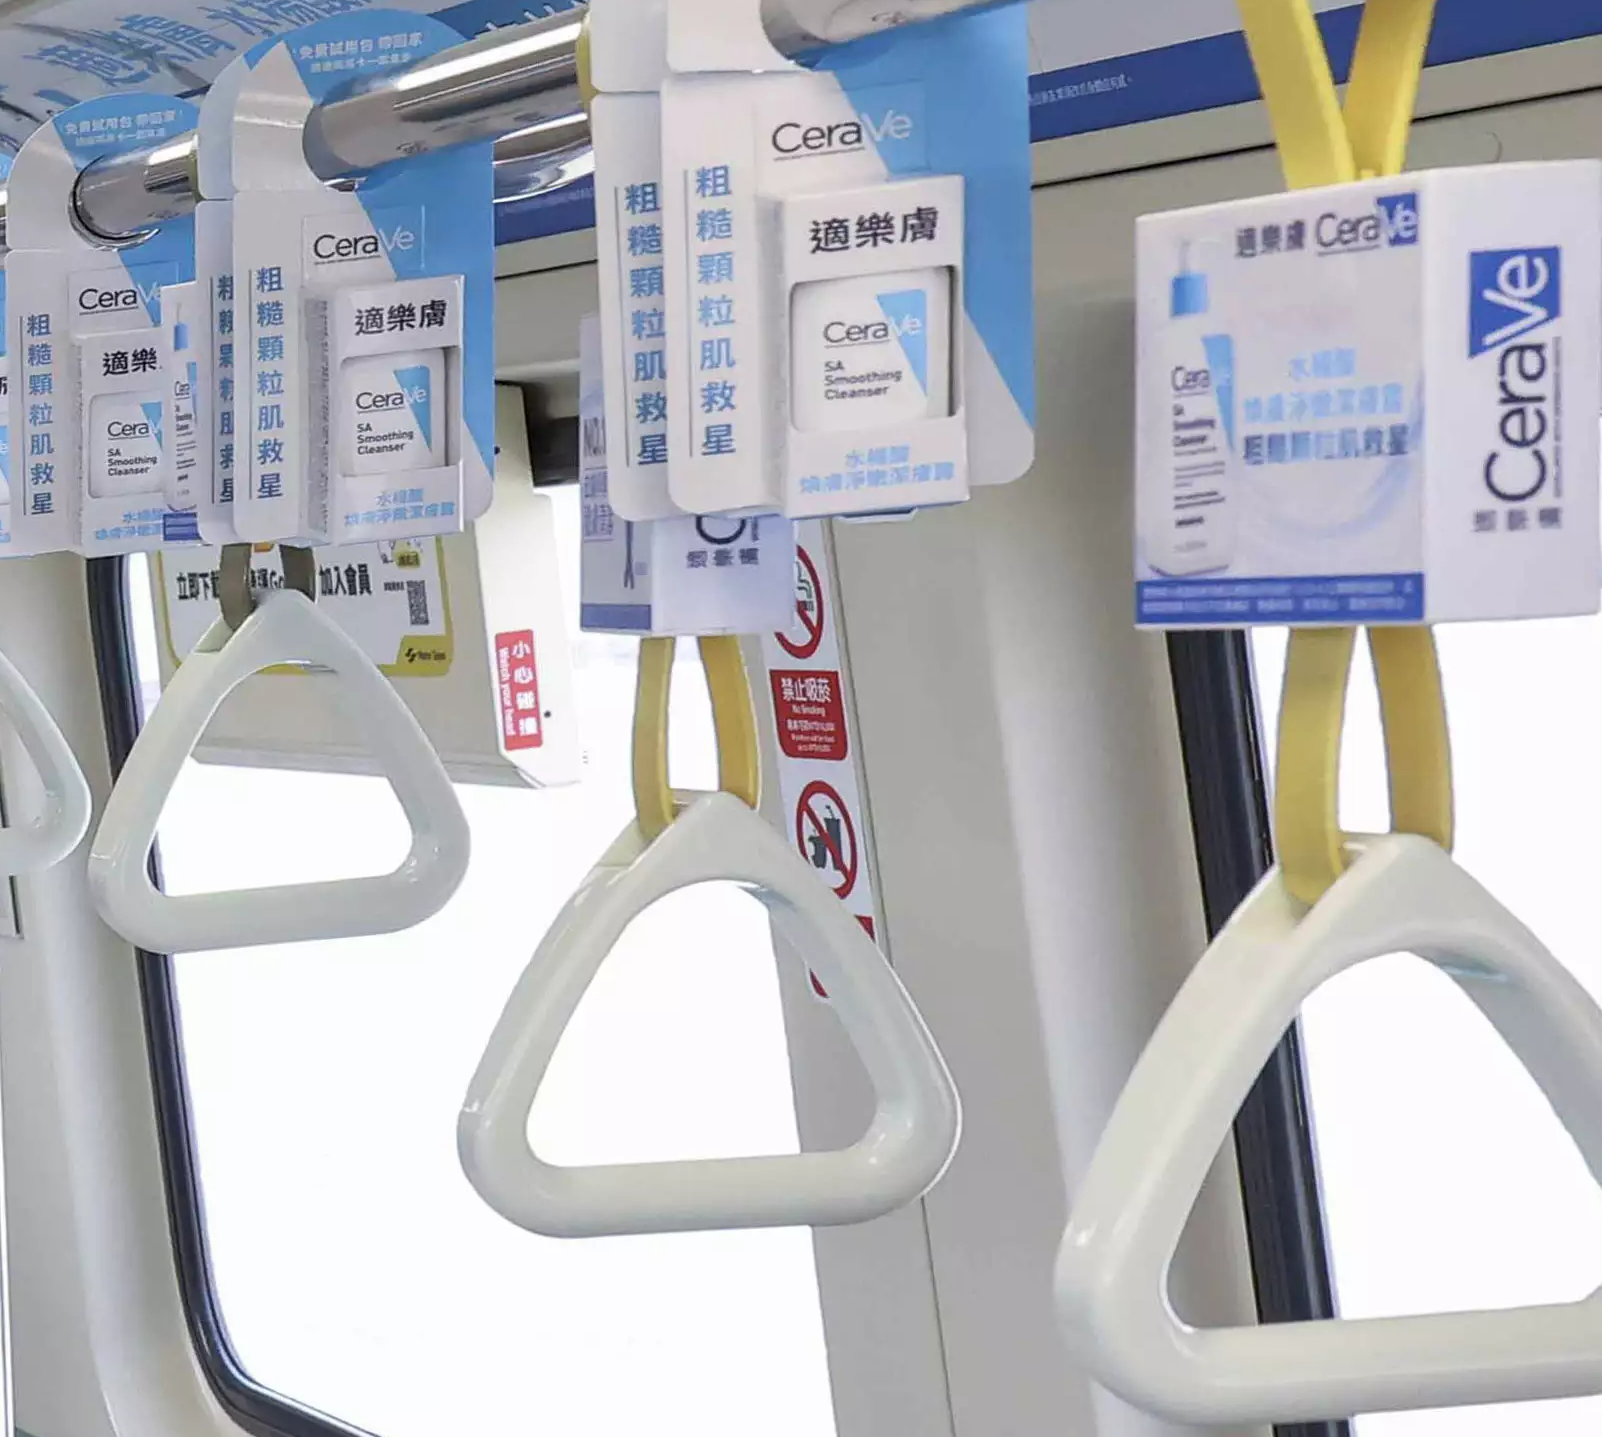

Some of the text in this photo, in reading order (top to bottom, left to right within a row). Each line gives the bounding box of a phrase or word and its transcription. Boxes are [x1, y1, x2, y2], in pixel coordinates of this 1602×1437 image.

[772, 108, 914, 156] CeraVe
[809, 206, 940, 255] 適樂膚
[1316, 196, 1418, 249] CeraVe
[313, 228, 415, 262] CeraVe
[354, 299, 448, 336] 適樂膚
[624, 181, 669, 466] 粗糙顆粒肌救星
[695, 163, 737, 457] 粗糙顆粒肌救星
[822, 312, 924, 345] CeraVe
[102, 347, 159, 377] 適樂
[823, 360, 845, 373] SA
[823, 367, 904, 388] Smoothing
[1479, 252, 1552, 503] CeraVe
[256, 266, 285, 500] 粗糙顆粒肌救星
[823, 384, 890, 402] Cleanser
[26, 313, 55, 516] 粗糙顆粒肌救星
[355, 387, 429, 411] CeraVe
[108, 419, 162, 439] CeraV
[357, 423, 373, 433] SA
[357, 429, 414, 444] Smoothing
[108, 448, 121, 458] SA
[108, 455, 158, 467] Smoothing
[357, 442, 406, 456] Cleanser
[108, 466, 150, 477] Cleanser
[318, 563, 373, 597] 加入會員
[501, 682, 513, 707] your
[511, 639, 539, 737] 小心碰撞
